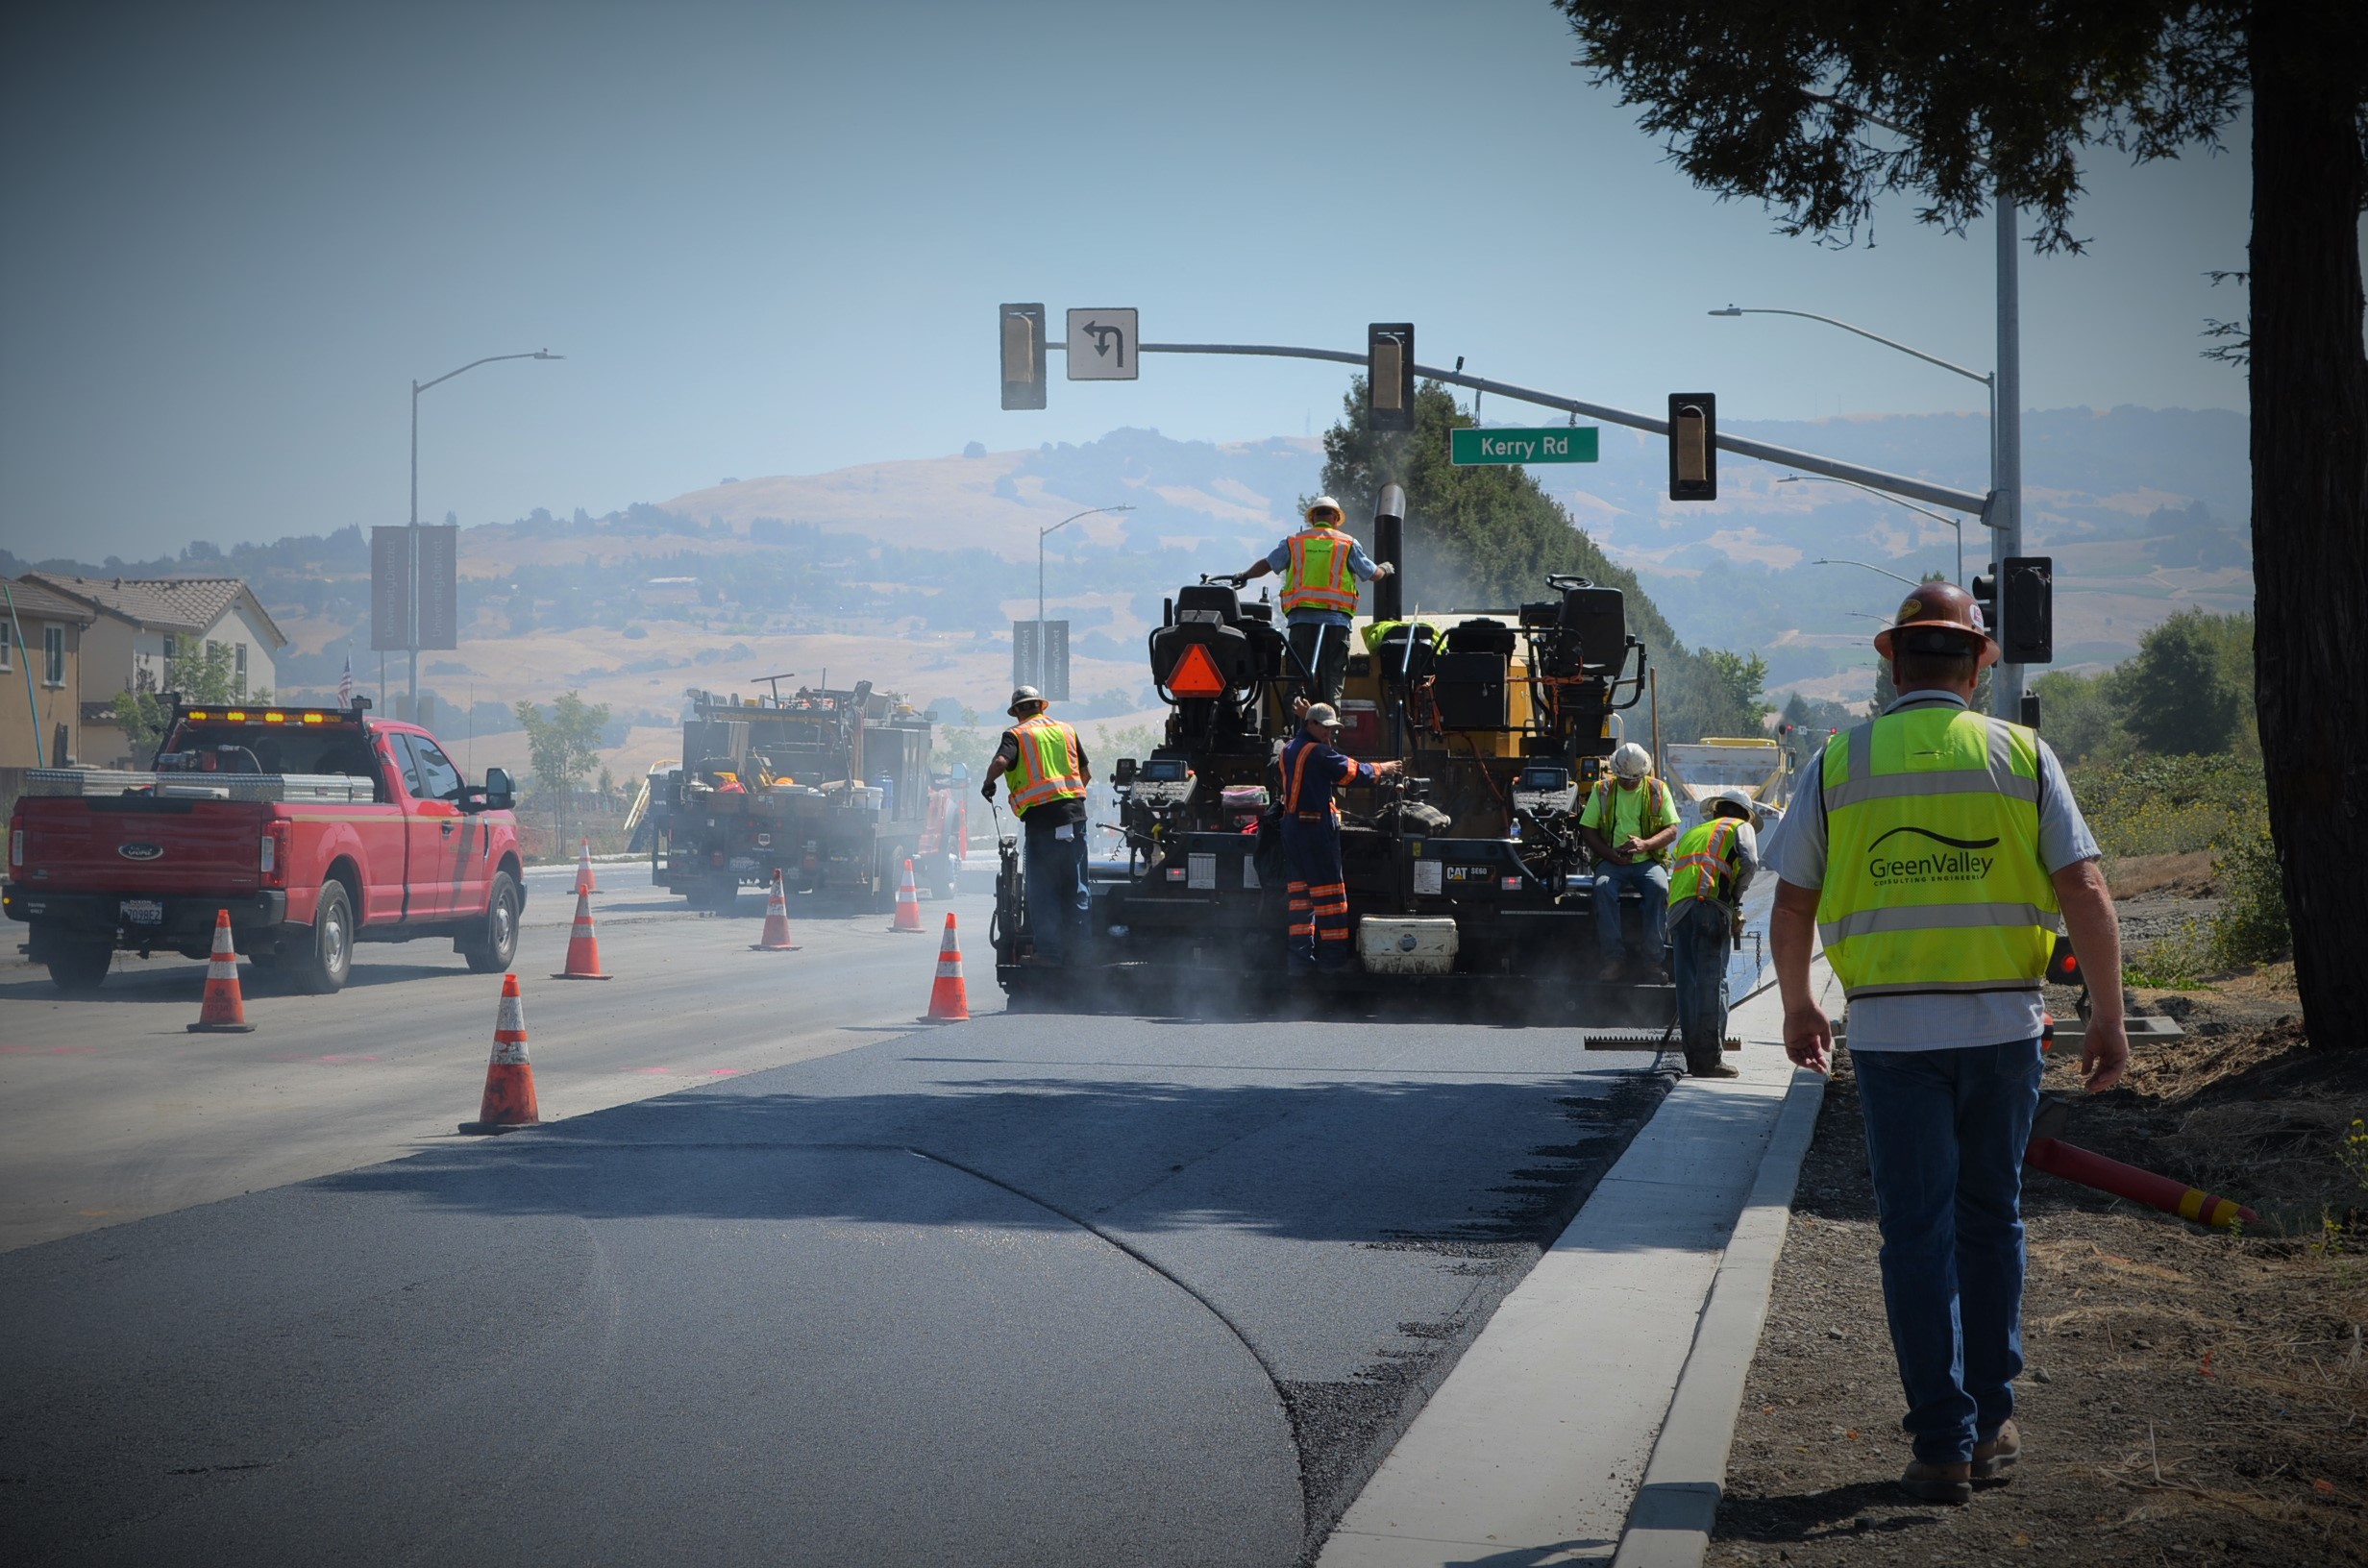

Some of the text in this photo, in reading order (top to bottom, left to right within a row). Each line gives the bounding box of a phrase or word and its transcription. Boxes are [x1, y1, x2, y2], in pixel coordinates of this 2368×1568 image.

[1481, 436, 1568, 459] Kerry Rd
[1446, 867, 1468, 880] CAT
[1869, 852, 1994, 879] GreenValley
